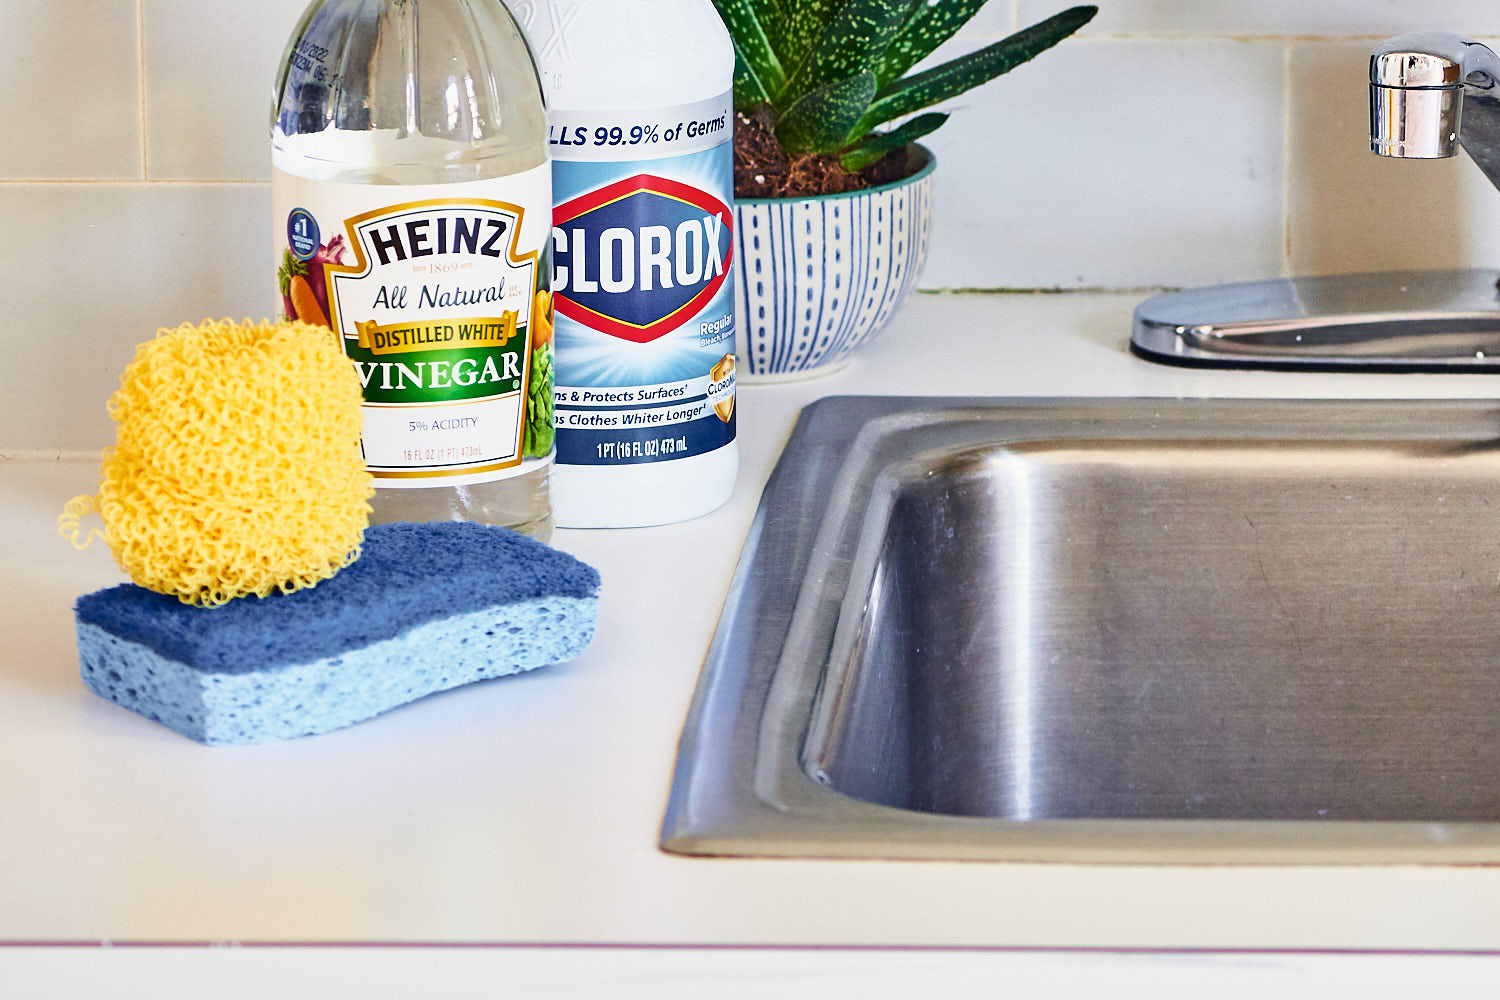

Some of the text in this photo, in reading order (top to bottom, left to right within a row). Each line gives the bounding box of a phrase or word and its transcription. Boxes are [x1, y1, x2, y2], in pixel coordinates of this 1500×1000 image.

[548, 125, 588, 146] LLS
[594, 124, 659, 147] 99.9%
[664, 122, 684, 142] of
[368, 217, 508, 266] HEINZ
[551, 211, 724, 294] CLOROX
[372, 276, 506, 309] All Natural
[373, 323, 506, 349] DISTILLED WHITE
[700, 313, 733, 336] Regular
[353, 351, 522, 390] VINEGAR
[570, 390, 581, 402] &
[582, 391, 635, 403] Protects
[408, 416, 479, 432] 5% ACIDITY
[568, 413, 618, 426] Clothes
[621, 411, 665, 425] Whiter
[403, 449, 412, 461] 16
[414, 449, 423, 461] FL
[425, 448, 435, 460] OZ
[596, 435, 689, 460] 1 PT (16 FL OZ) 473 mL
